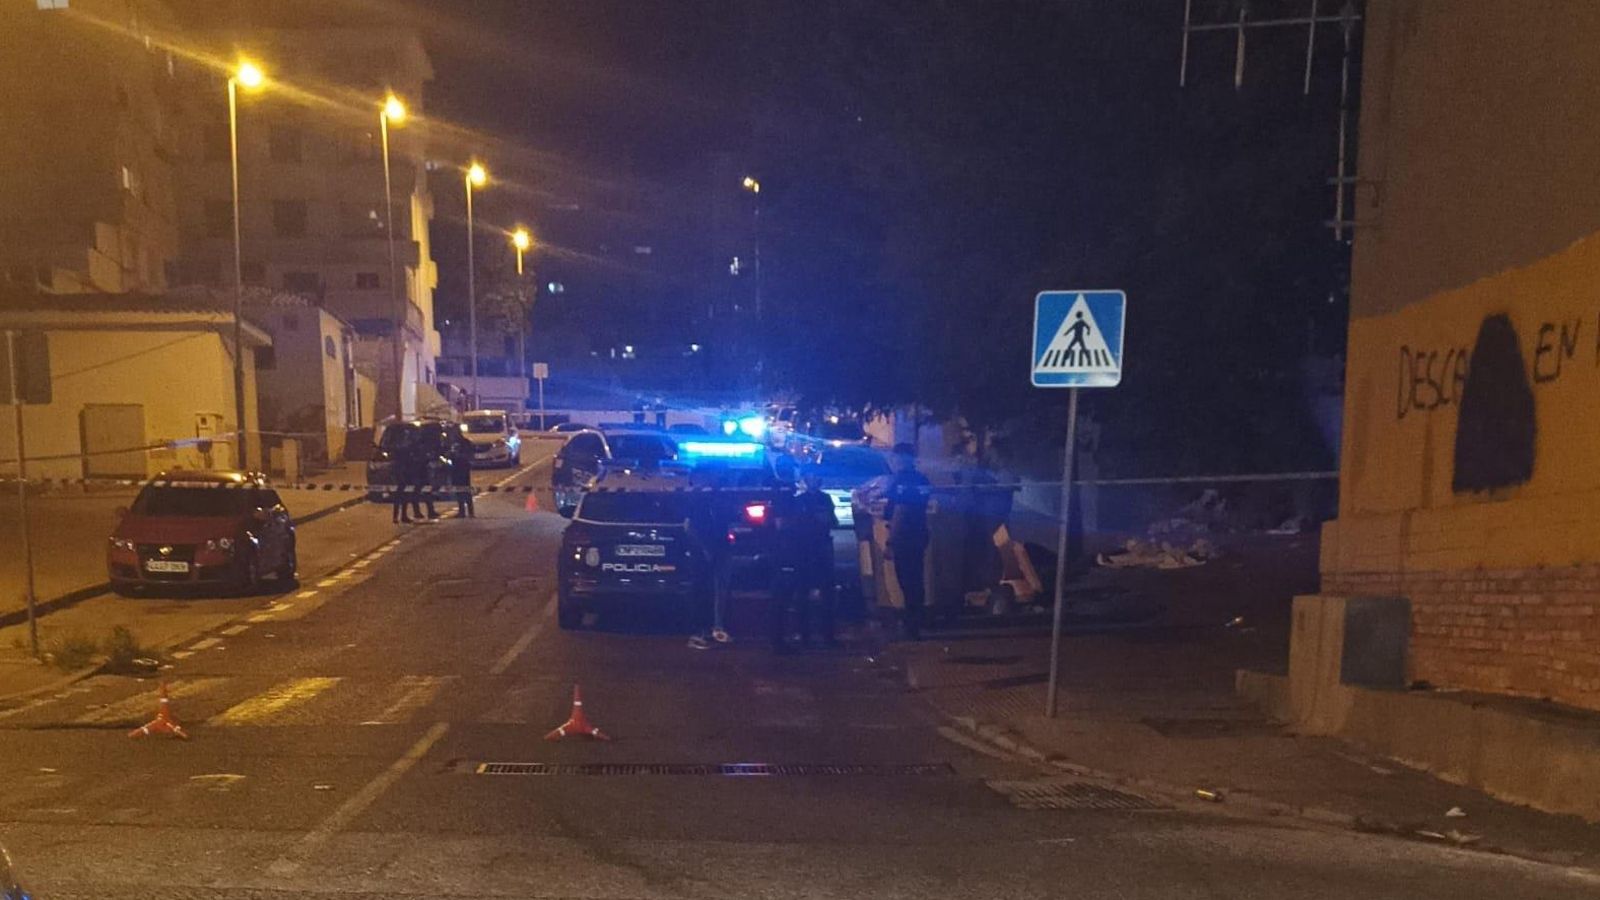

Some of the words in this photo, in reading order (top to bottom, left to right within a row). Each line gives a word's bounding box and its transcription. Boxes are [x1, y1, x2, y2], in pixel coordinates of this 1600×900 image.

[1397, 345, 1470, 420] DESCA
[1533, 318, 1581, 384] EN
[602, 563, 661, 572] POLICIA
